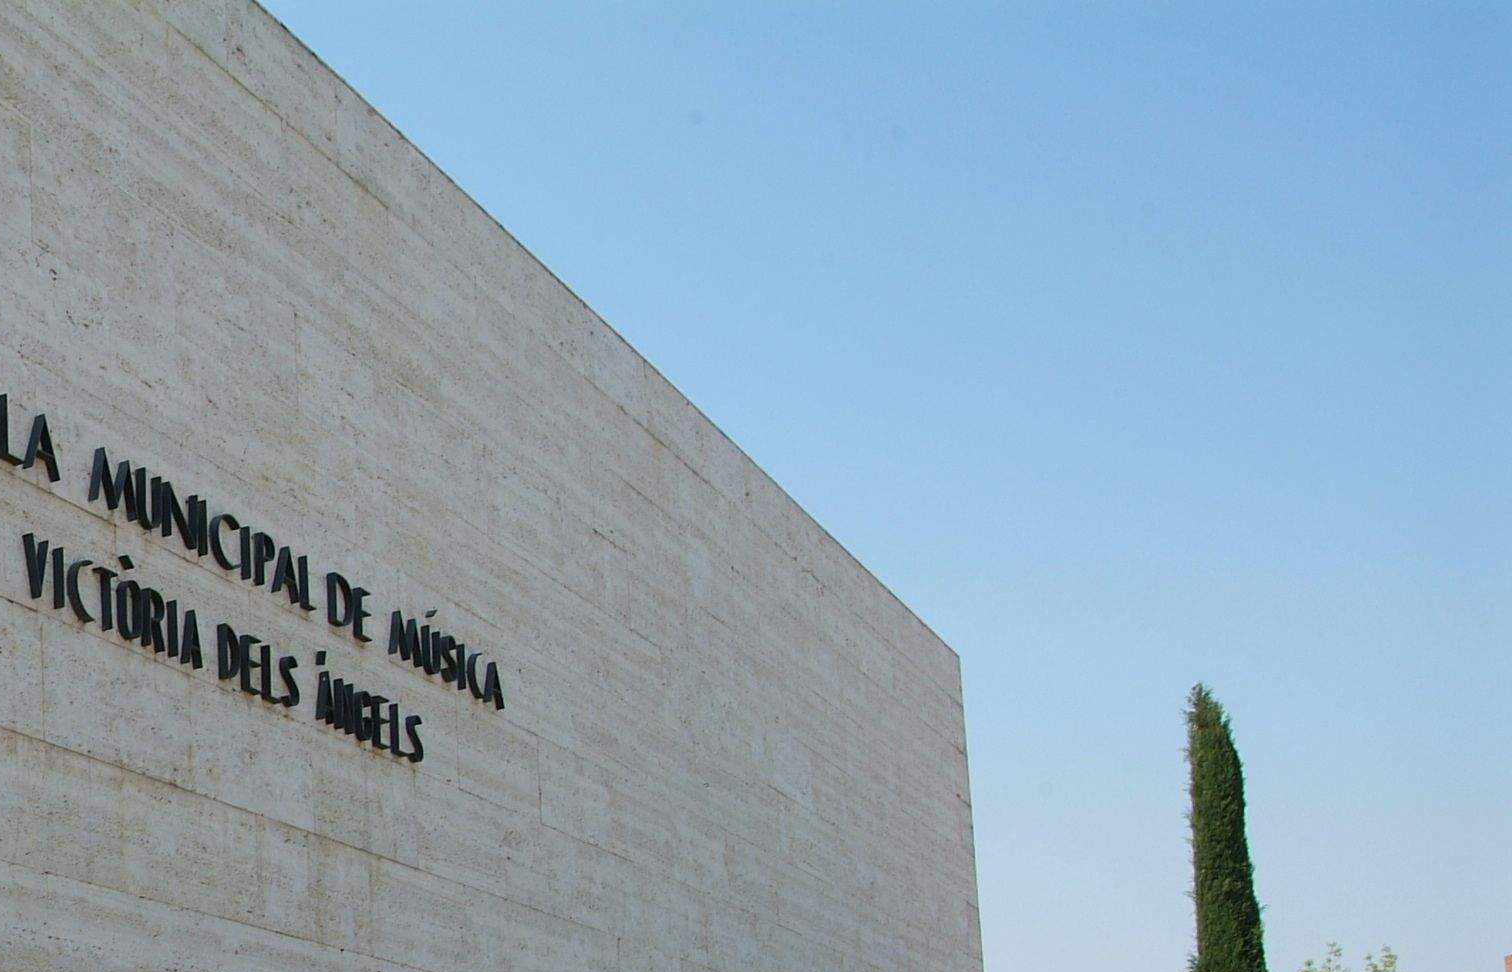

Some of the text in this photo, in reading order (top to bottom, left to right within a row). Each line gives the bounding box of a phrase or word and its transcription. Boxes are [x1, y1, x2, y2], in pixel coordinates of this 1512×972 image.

[21, 532, 204, 670] VICTÒRIA
[216, 622, 300, 708] DELS
[88, 446, 317, 612] MUNICIPAL
[325, 572, 373, 643] DE
[387, 609, 505, 711] MÚSICA
